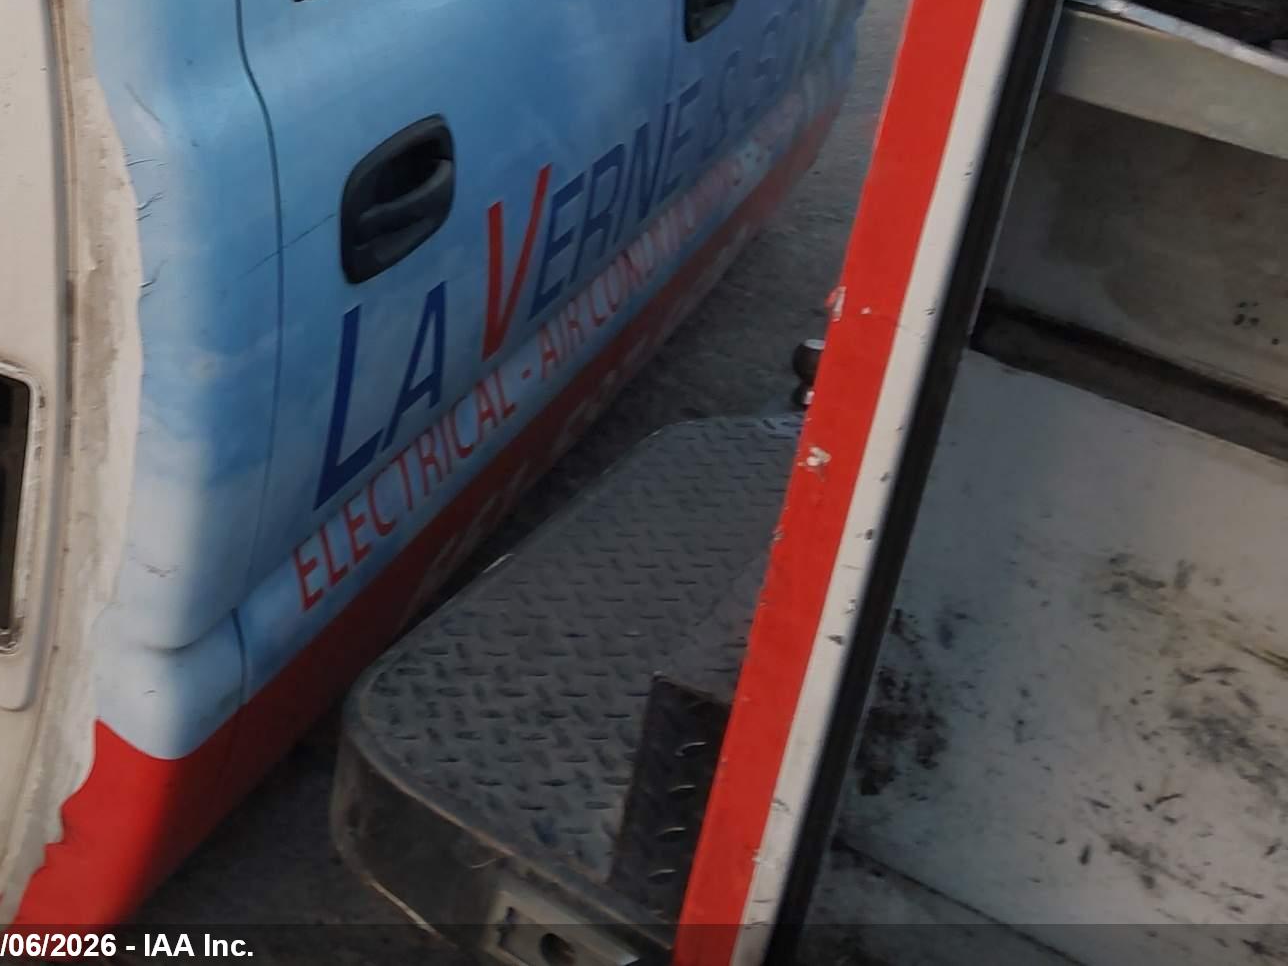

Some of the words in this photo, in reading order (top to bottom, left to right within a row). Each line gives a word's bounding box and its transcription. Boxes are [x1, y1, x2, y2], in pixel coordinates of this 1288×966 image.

[292, 372, 518, 614] ELECTRICAL
[537, 297, 586, 380] AIR
[313, 279, 448, 511] LA
[481, 76, 705, 362] VERNE
